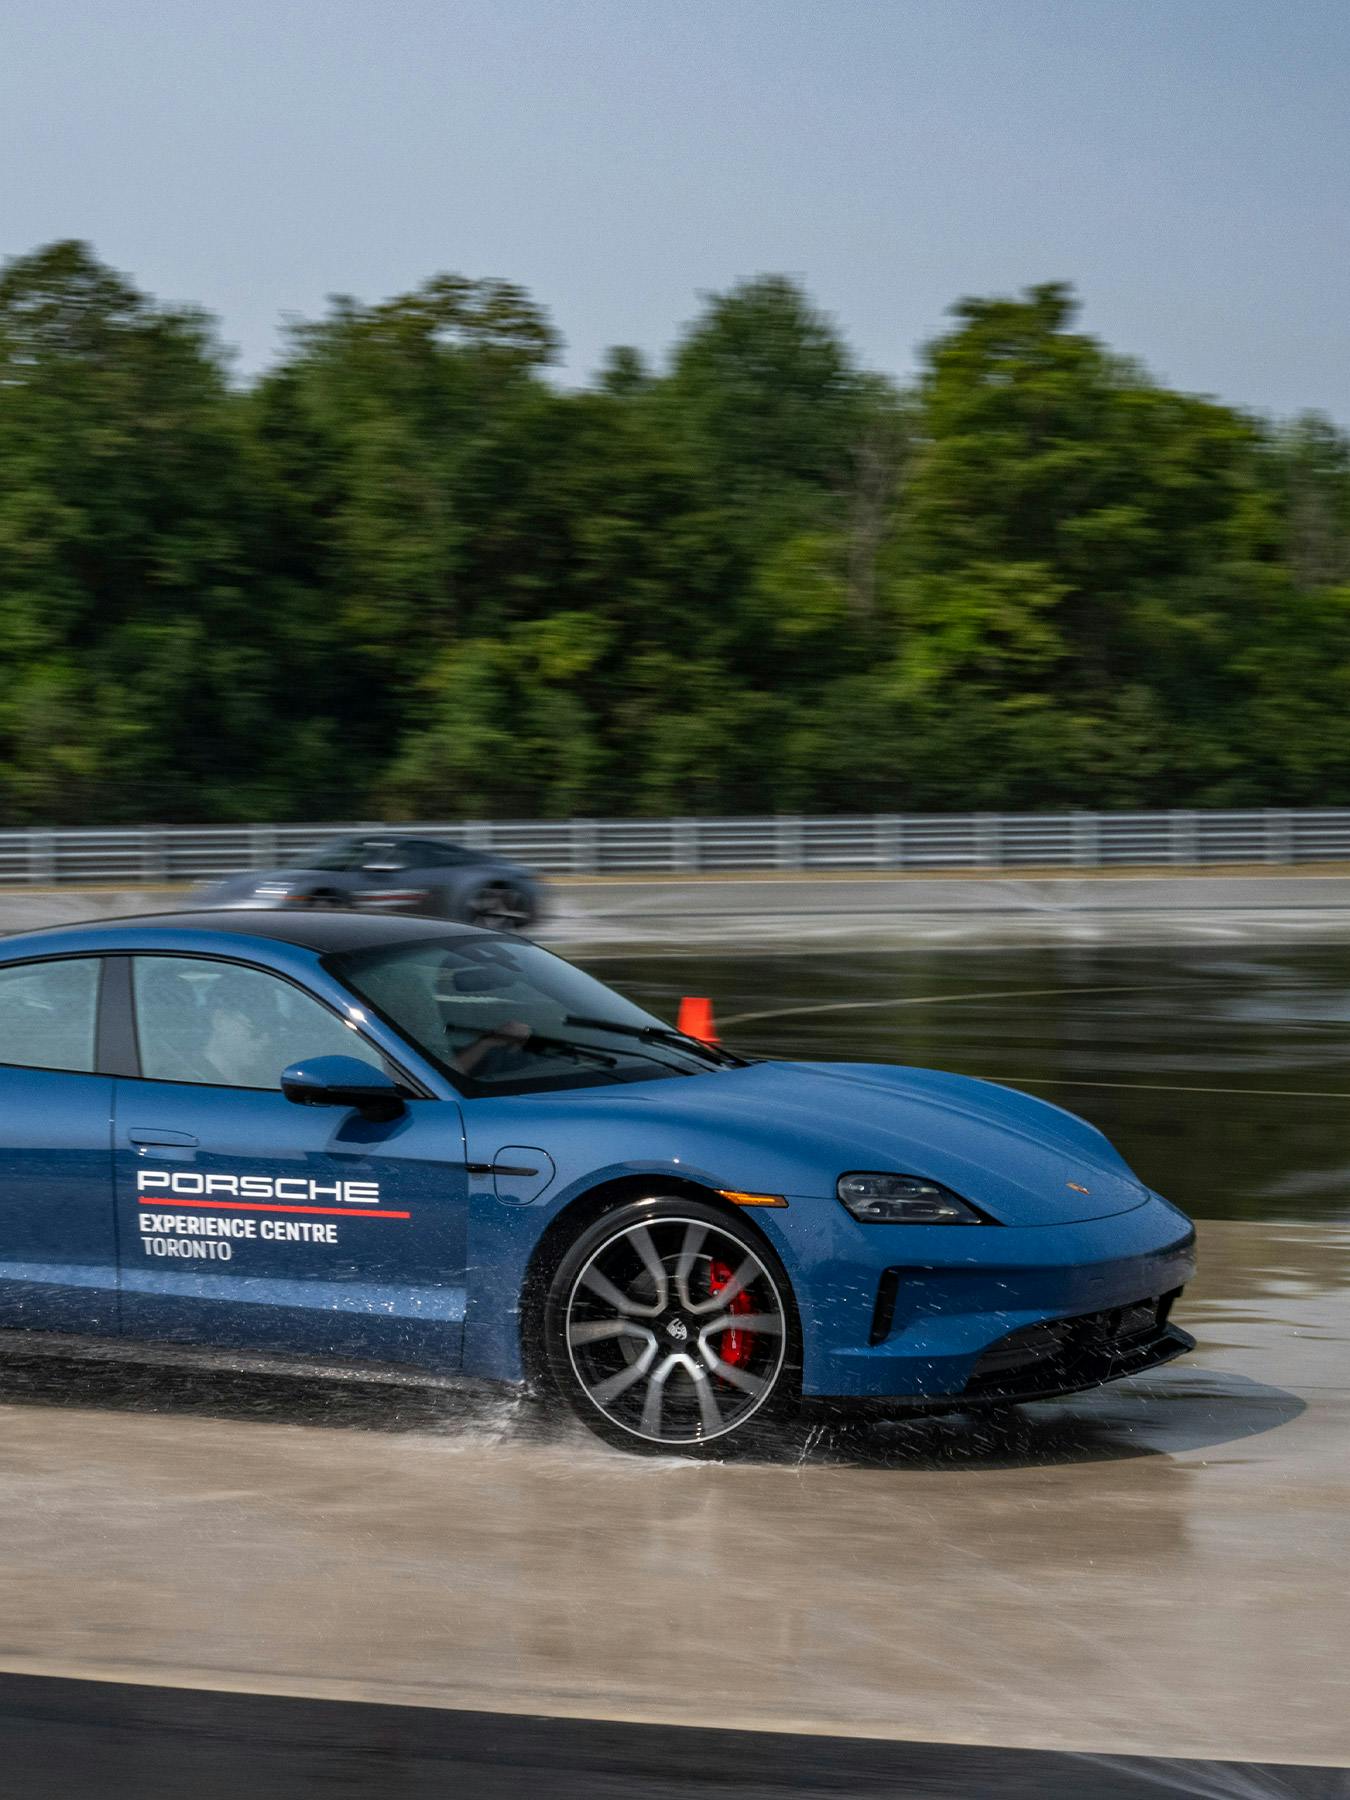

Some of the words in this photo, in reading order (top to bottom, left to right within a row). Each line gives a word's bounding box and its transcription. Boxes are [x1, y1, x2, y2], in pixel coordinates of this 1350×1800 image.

[137, 1171, 379, 1203] PORSCHE
[139, 1213, 257, 1239] EXPERIENCE
[260, 1220, 338, 1244] CENTRE
[141, 1237, 232, 1261] TORONTO
